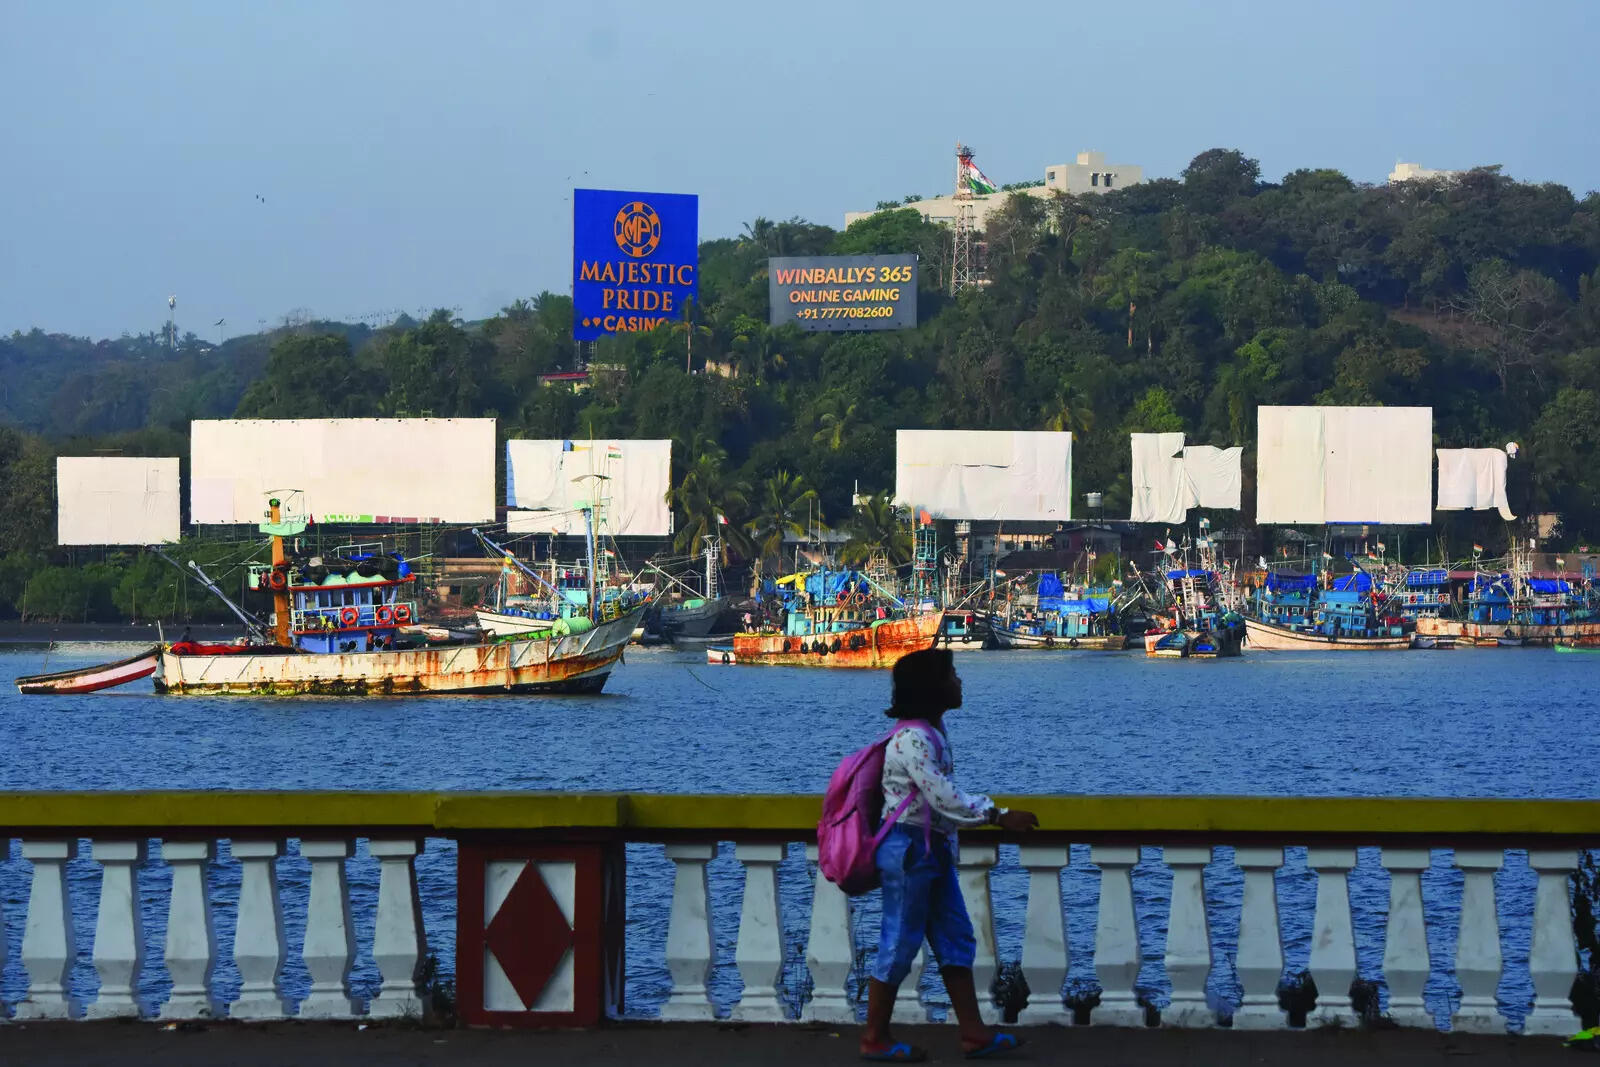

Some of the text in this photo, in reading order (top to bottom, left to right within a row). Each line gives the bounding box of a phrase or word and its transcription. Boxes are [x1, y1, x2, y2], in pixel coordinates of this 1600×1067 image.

[579, 260, 693, 286] MAJESTIC
[776, 266, 912, 285] WINBALLYS 365
[602, 288, 673, 311] PRIDE
[789, 288, 900, 303] ONLINE GAMING
[796, 306, 893, 319] +91 7777082600
